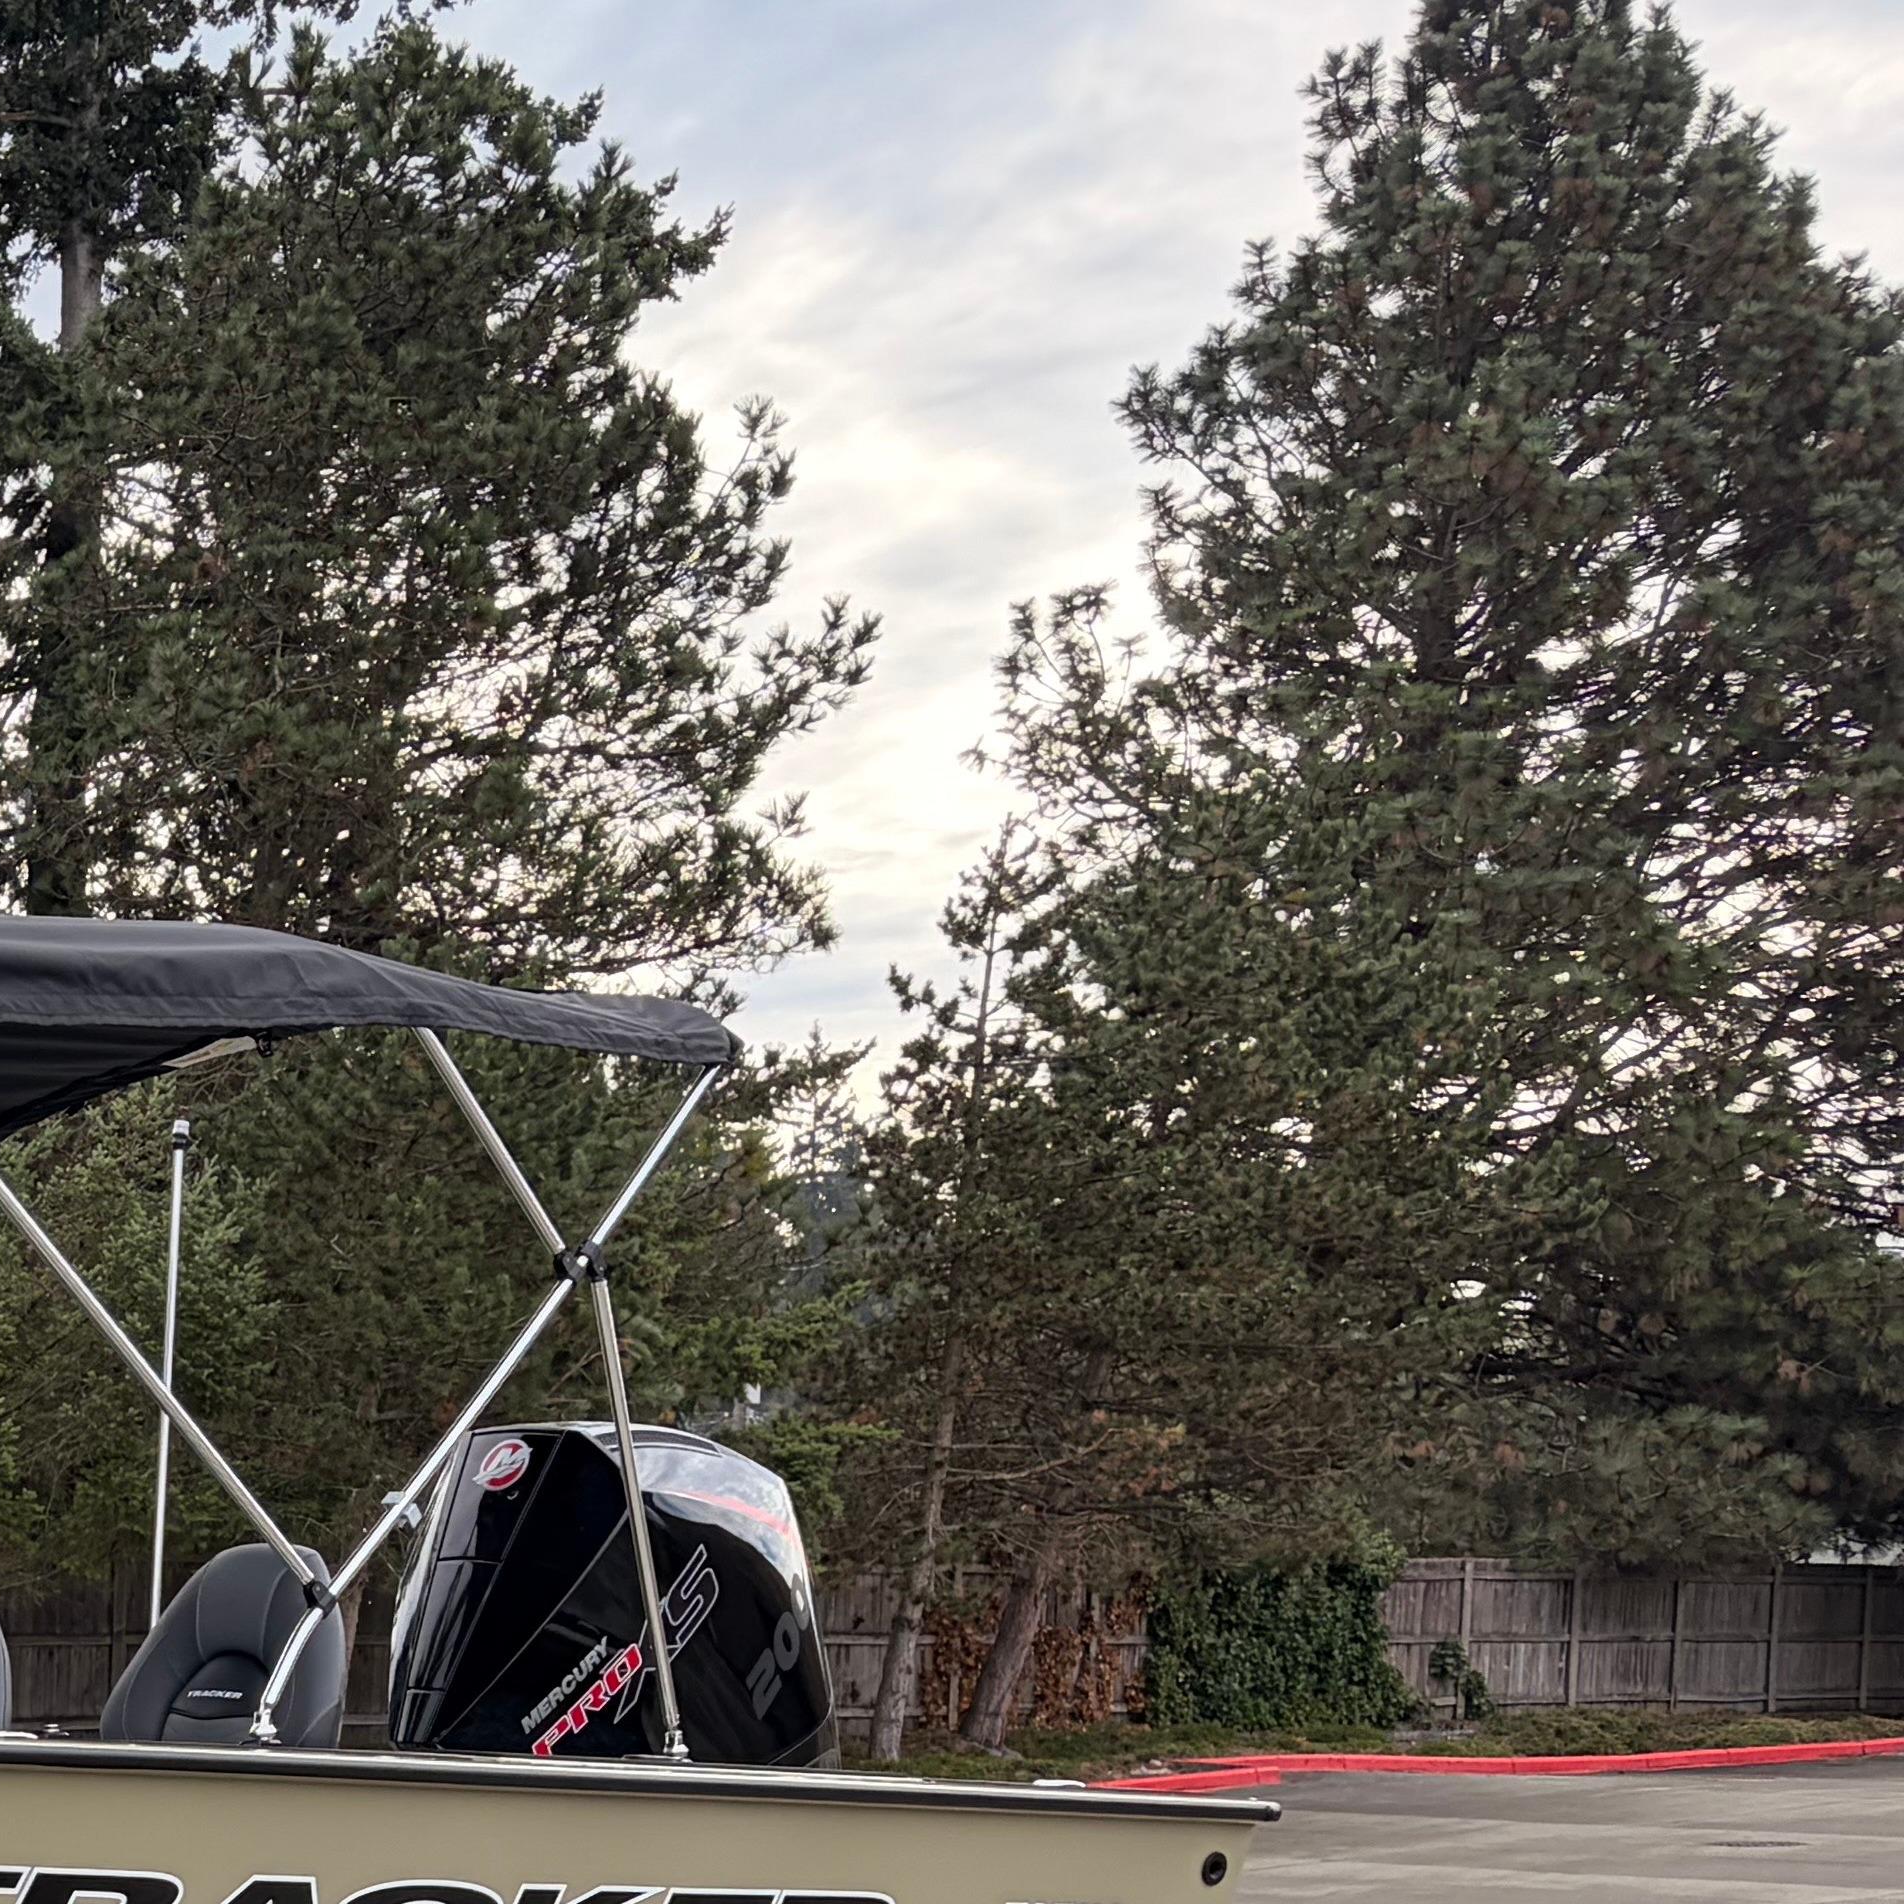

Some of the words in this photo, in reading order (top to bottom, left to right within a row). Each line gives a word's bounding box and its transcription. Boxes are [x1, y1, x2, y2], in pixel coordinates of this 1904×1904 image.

[187, 1690, 243, 1699] TRACKER
[520, 1635, 608, 1735] MERCURY
[532, 1643, 642, 1756] PRO
[745, 1573, 810, 1720] 200
